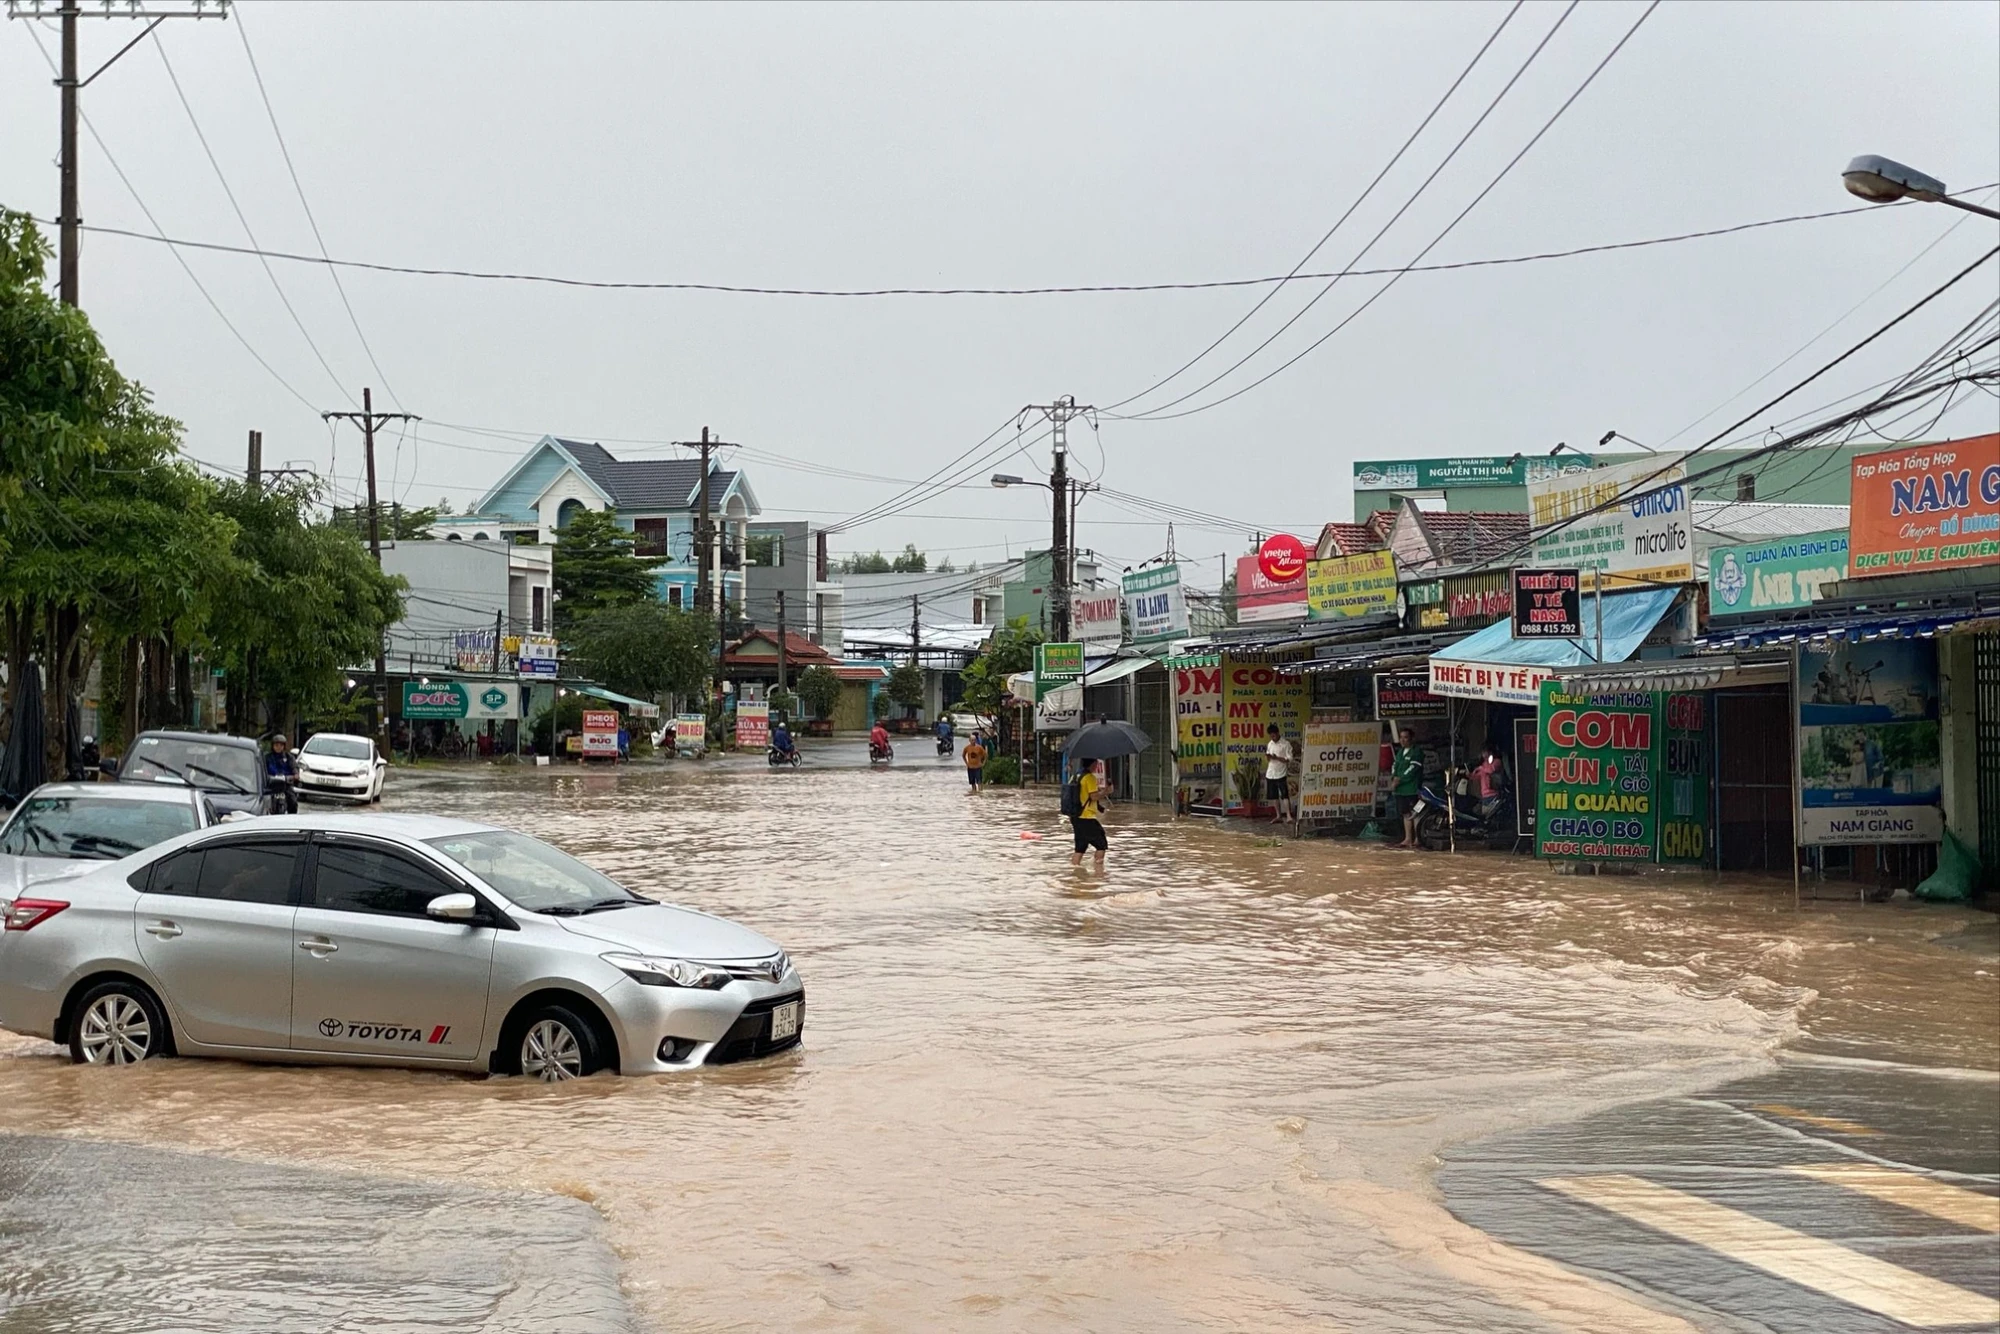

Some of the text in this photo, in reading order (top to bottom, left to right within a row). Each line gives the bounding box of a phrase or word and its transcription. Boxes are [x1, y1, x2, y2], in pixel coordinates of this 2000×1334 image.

[1429, 466, 1470, 477] NGUYỄN
[1472, 467, 1489, 478] THỊ
[1856, 452, 1956, 479] Tạp Hóa Tổng Hợp
[1891, 469, 1971, 517] NAM
[1940, 513, 1959, 536] ĐỒ
[1635, 522, 1687, 555] microlife
[1830, 534, 1849, 553] DÂ
[1856, 552, 1890, 571] DỊCH
[1893, 549, 1914, 568] VỤ
[1916, 547, 1936, 563] XE
[1519, 572, 1558, 590] THIẾT
[1560, 574, 1575, 592] BỊ
[1136, 593, 1169, 618] HÀ LINH
[1534, 589, 1563, 607] Y TẾ
[1530, 609, 1567, 623] NASA
[1521, 624, 1576, 634] 0988 415 292
[1397, 678, 1428, 688] Coffee
[1434, 664, 1472, 684] THIẾT
[1477, 670, 1492, 689] BỊ
[1496, 671, 1505, 687] Y
[1509, 668, 1529, 689] TẾ
[1619, 692, 1653, 708] THOA
[1548, 710, 1651, 750] CƠM
[1320, 747, 1363, 761] coffee
[1624, 752, 1647, 772] TÁI
[1544, 752, 1599, 785] BÚN
[1303, 792, 1328, 806] NƯỚC
[1545, 791, 1568, 810] MÌ
[1574, 791, 1649, 813] QUẢNG
[1613, 817, 1644, 839] BÒ
[1830, 819, 1914, 832] NAM GIANG
[1542, 841, 1651, 858] NƯỚC GIẢI KHÁT
[348, 1025, 422, 1042] TOYOTA
